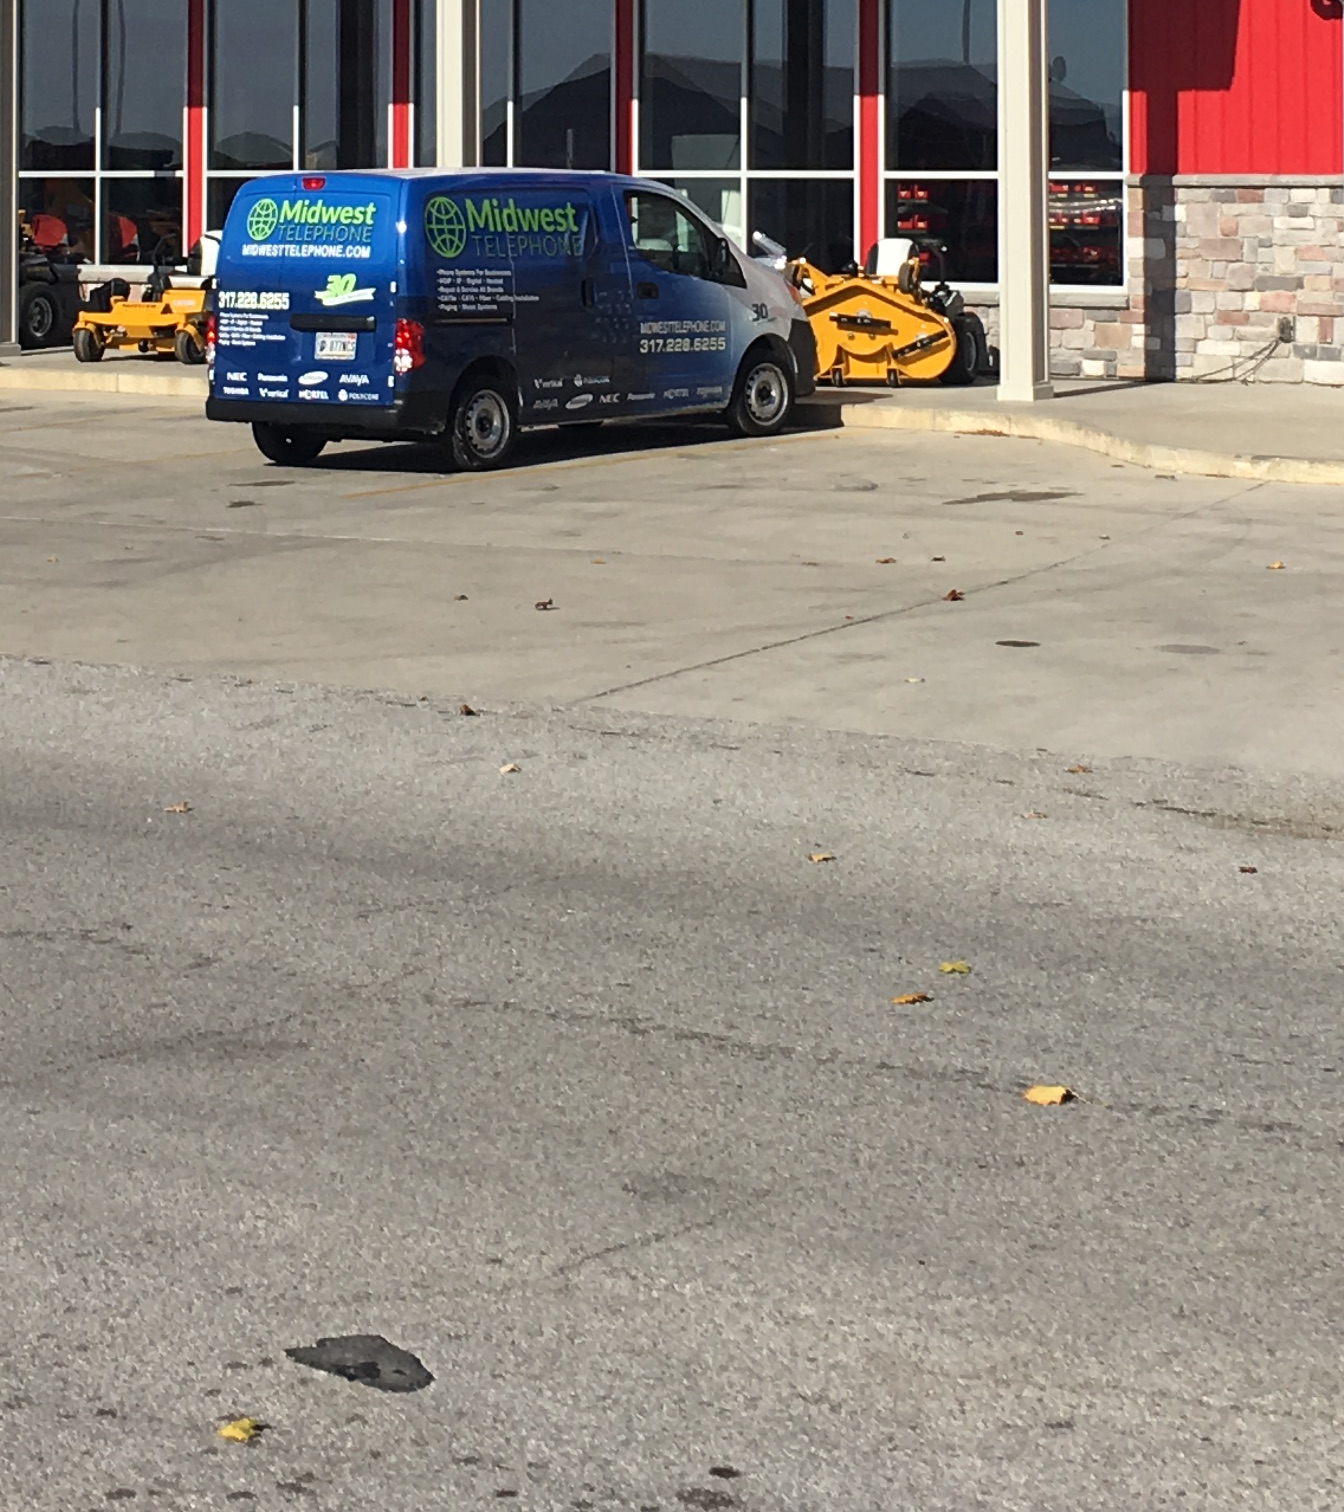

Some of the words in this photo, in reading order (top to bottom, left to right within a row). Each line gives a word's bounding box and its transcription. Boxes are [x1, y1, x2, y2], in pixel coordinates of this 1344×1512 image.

[279, 199, 376, 225] Midwest
[465, 198, 579, 232] Midwest
[278, 225, 373, 242] TELEPHONE
[242, 244, 371, 258] MIDWESTTELEPHONE.COM
[471, 235, 587, 257] TELEPHONE
[326, 273, 357, 298] 30
[218, 292, 290, 310] 317.228.6255
[751, 302, 768, 322] 30
[640, 337, 726, 353] 317.228.6255
[227, 372, 247, 382] NEC
[599, 393, 620, 404] NEC
